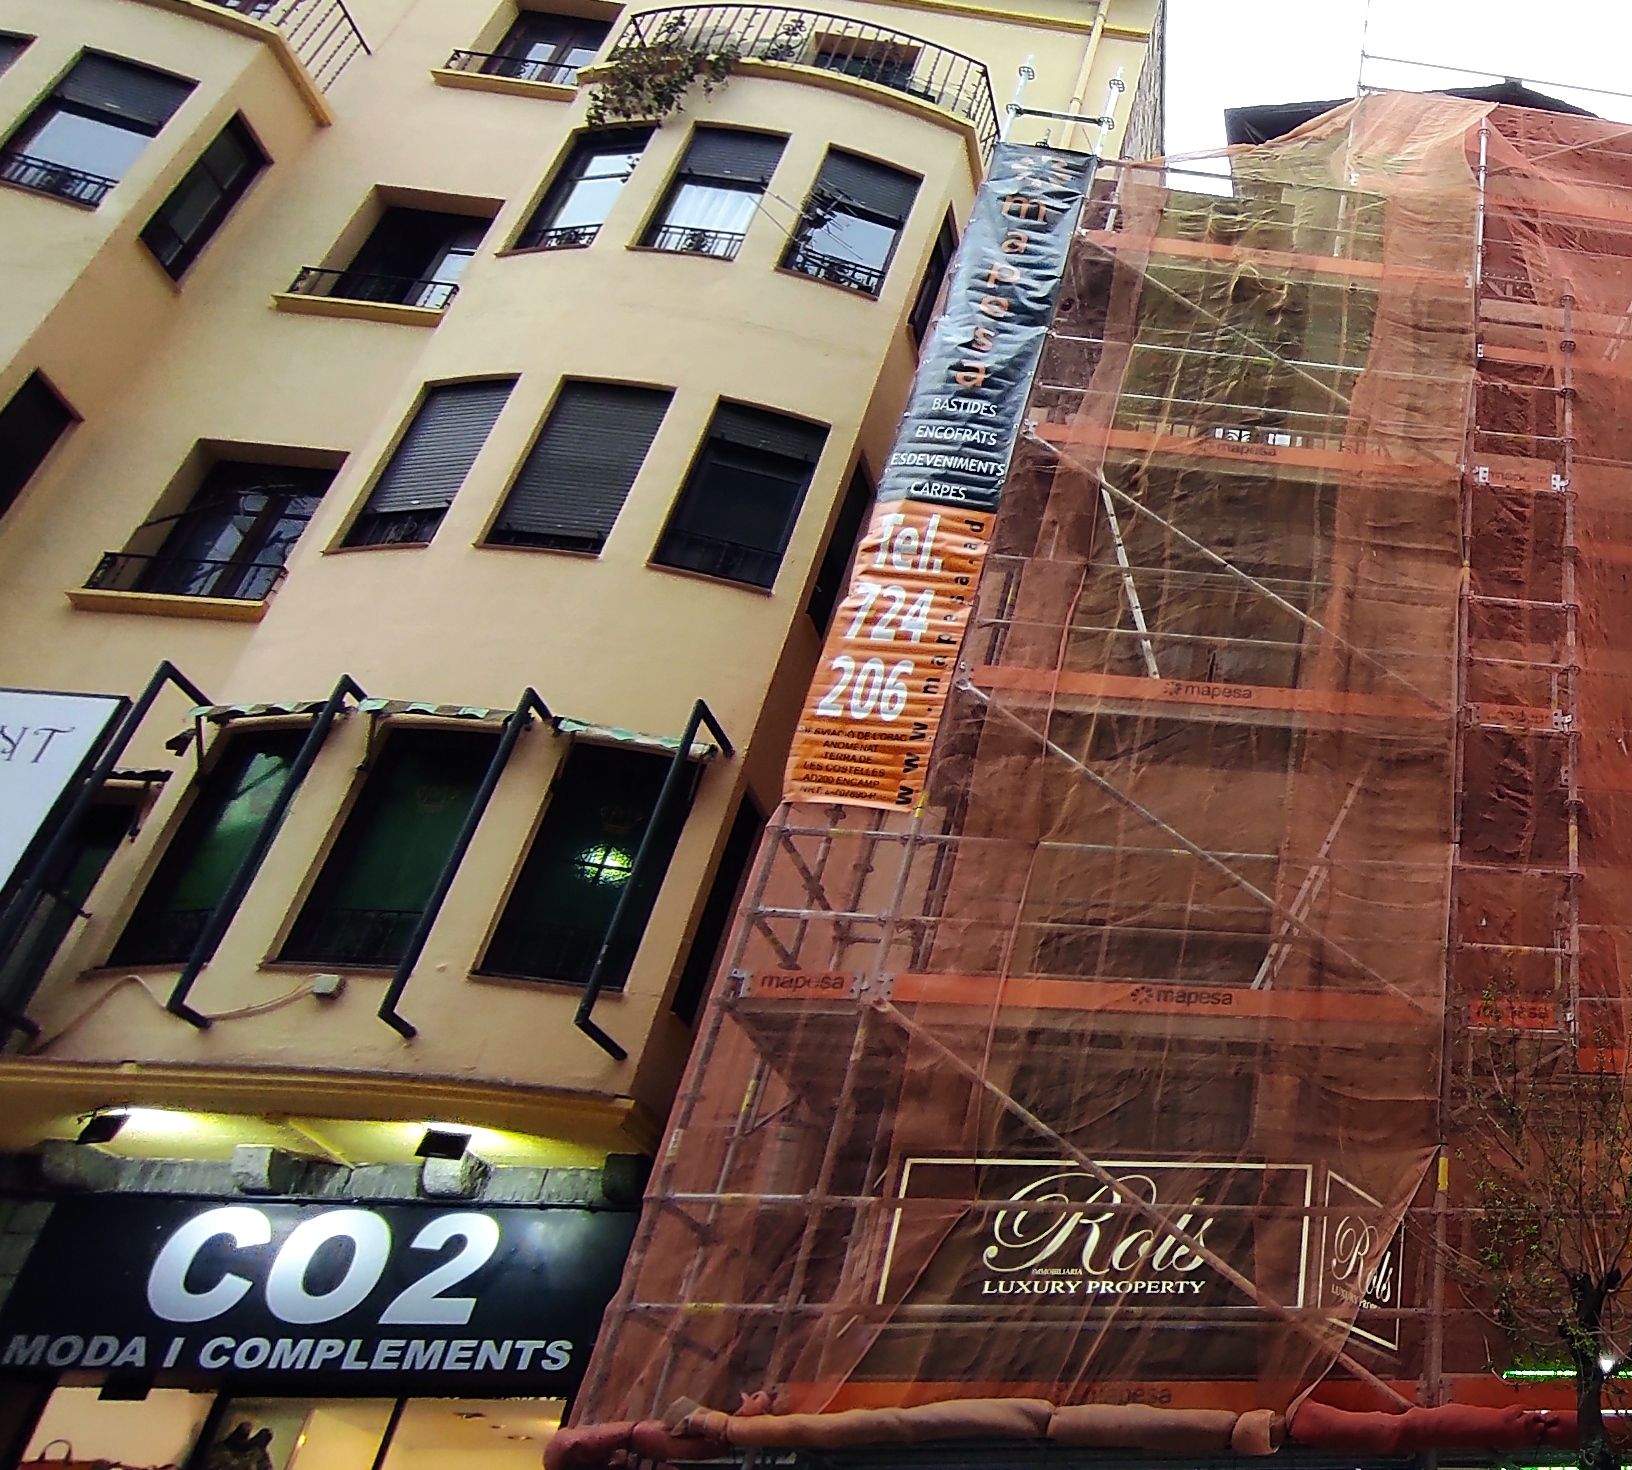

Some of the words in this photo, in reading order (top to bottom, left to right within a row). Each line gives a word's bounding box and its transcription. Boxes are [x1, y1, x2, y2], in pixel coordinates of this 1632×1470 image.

[932, 398, 997, 416] BASTIDES
[915, 425, 997, 446] ENCOFRATS
[891, 453, 1005, 477] ESDEVENIMENTS
[910, 481, 967, 500] CARPES
[843, 581, 935, 643] 724
[815, 656, 914, 721] 206
[1184, 684, 1252, 699] mapesa
[1156, 990, 1233, 1006] mapesa
[147, 1206, 501, 1326] CO2
[982, 1280, 1082, 1295] LUXURY
[1085, 1280, 1207, 1295] PROPERTY
[2, 1334, 148, 1369] MODA
[163, 1336, 182, 1368] I
[198, 1335, 574, 1372] COMPLEMENTS
